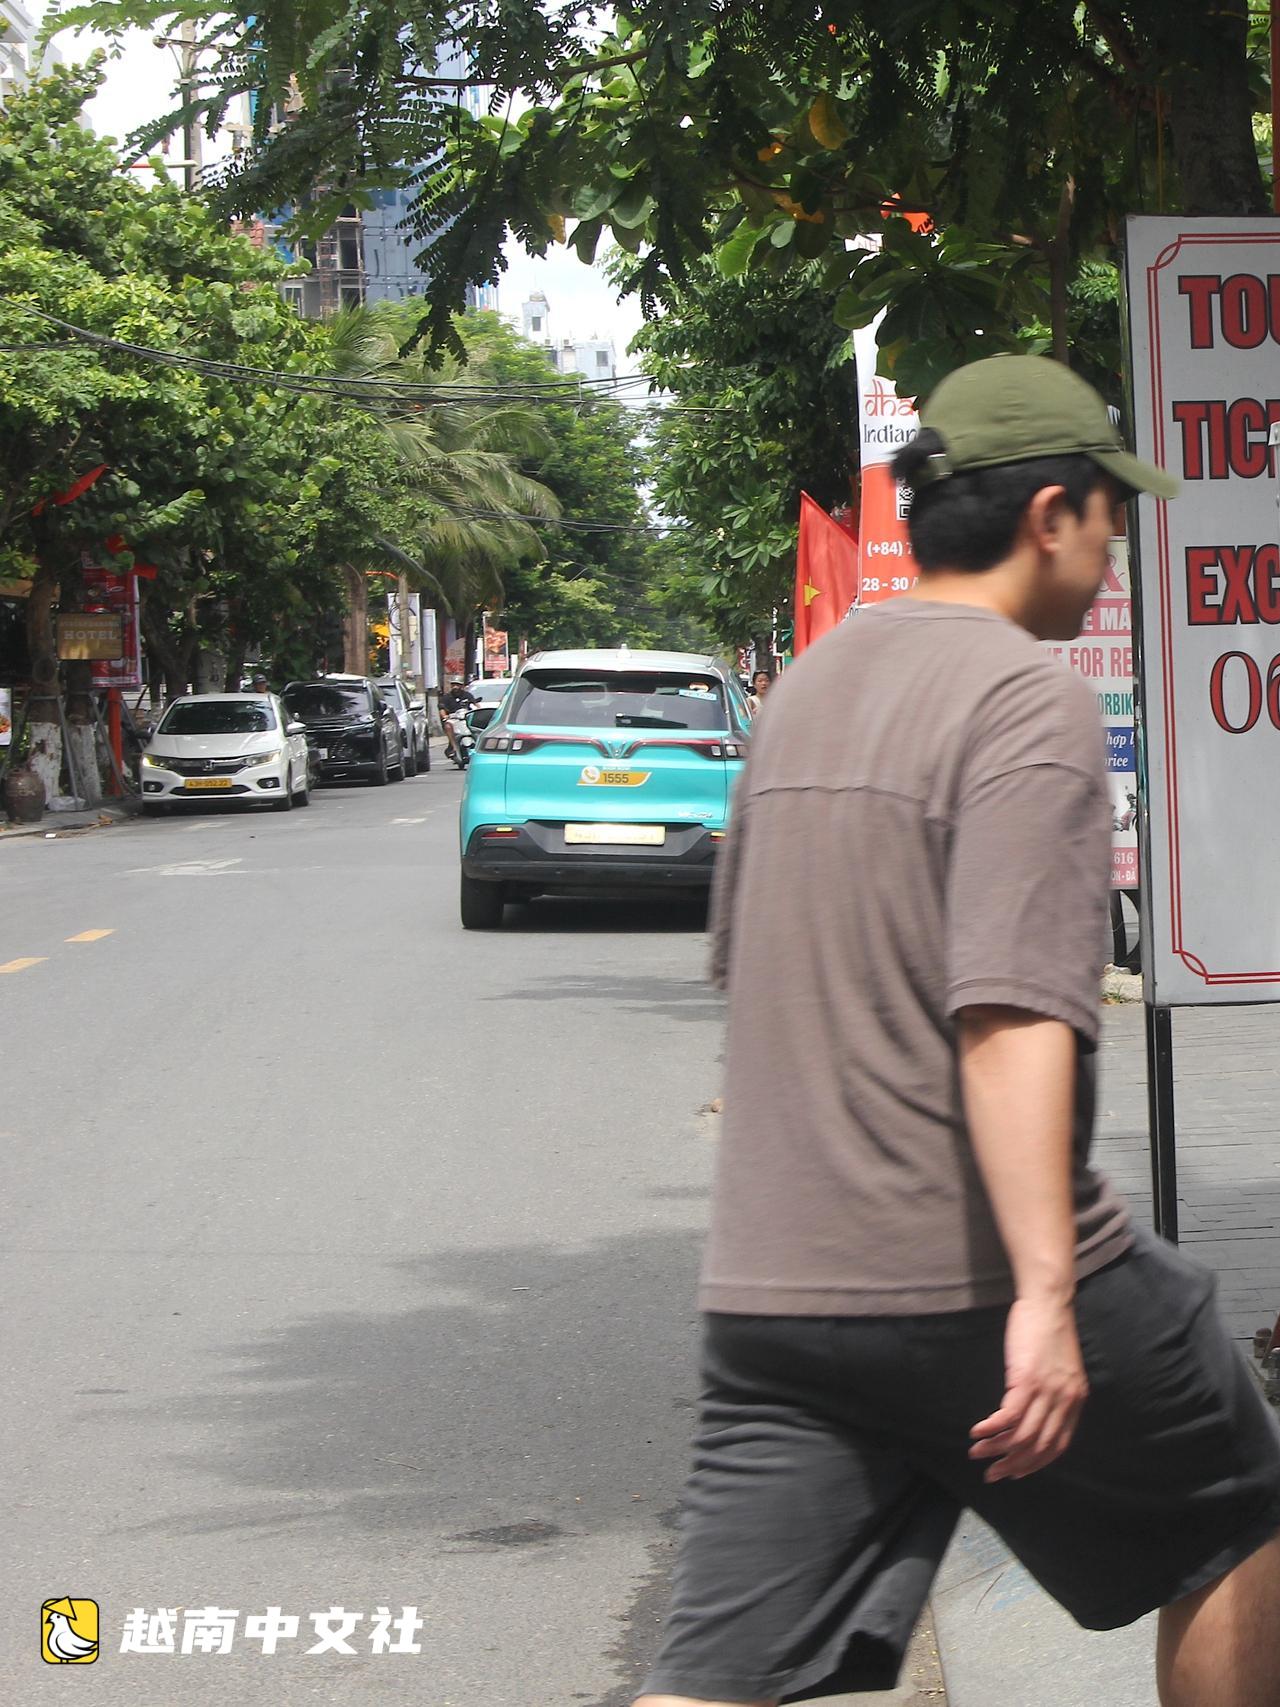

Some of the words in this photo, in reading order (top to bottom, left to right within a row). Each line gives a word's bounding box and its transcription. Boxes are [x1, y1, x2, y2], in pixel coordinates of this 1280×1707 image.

[867, 541, 903, 558] (+84)
[862, 577, 880, 591] 28
[891, 576, 909, 591] 30
[64, 630, 116, 640] HOTEL
[603, 773, 629, 784] 1555
[1113, 851, 1134, 865] 616
